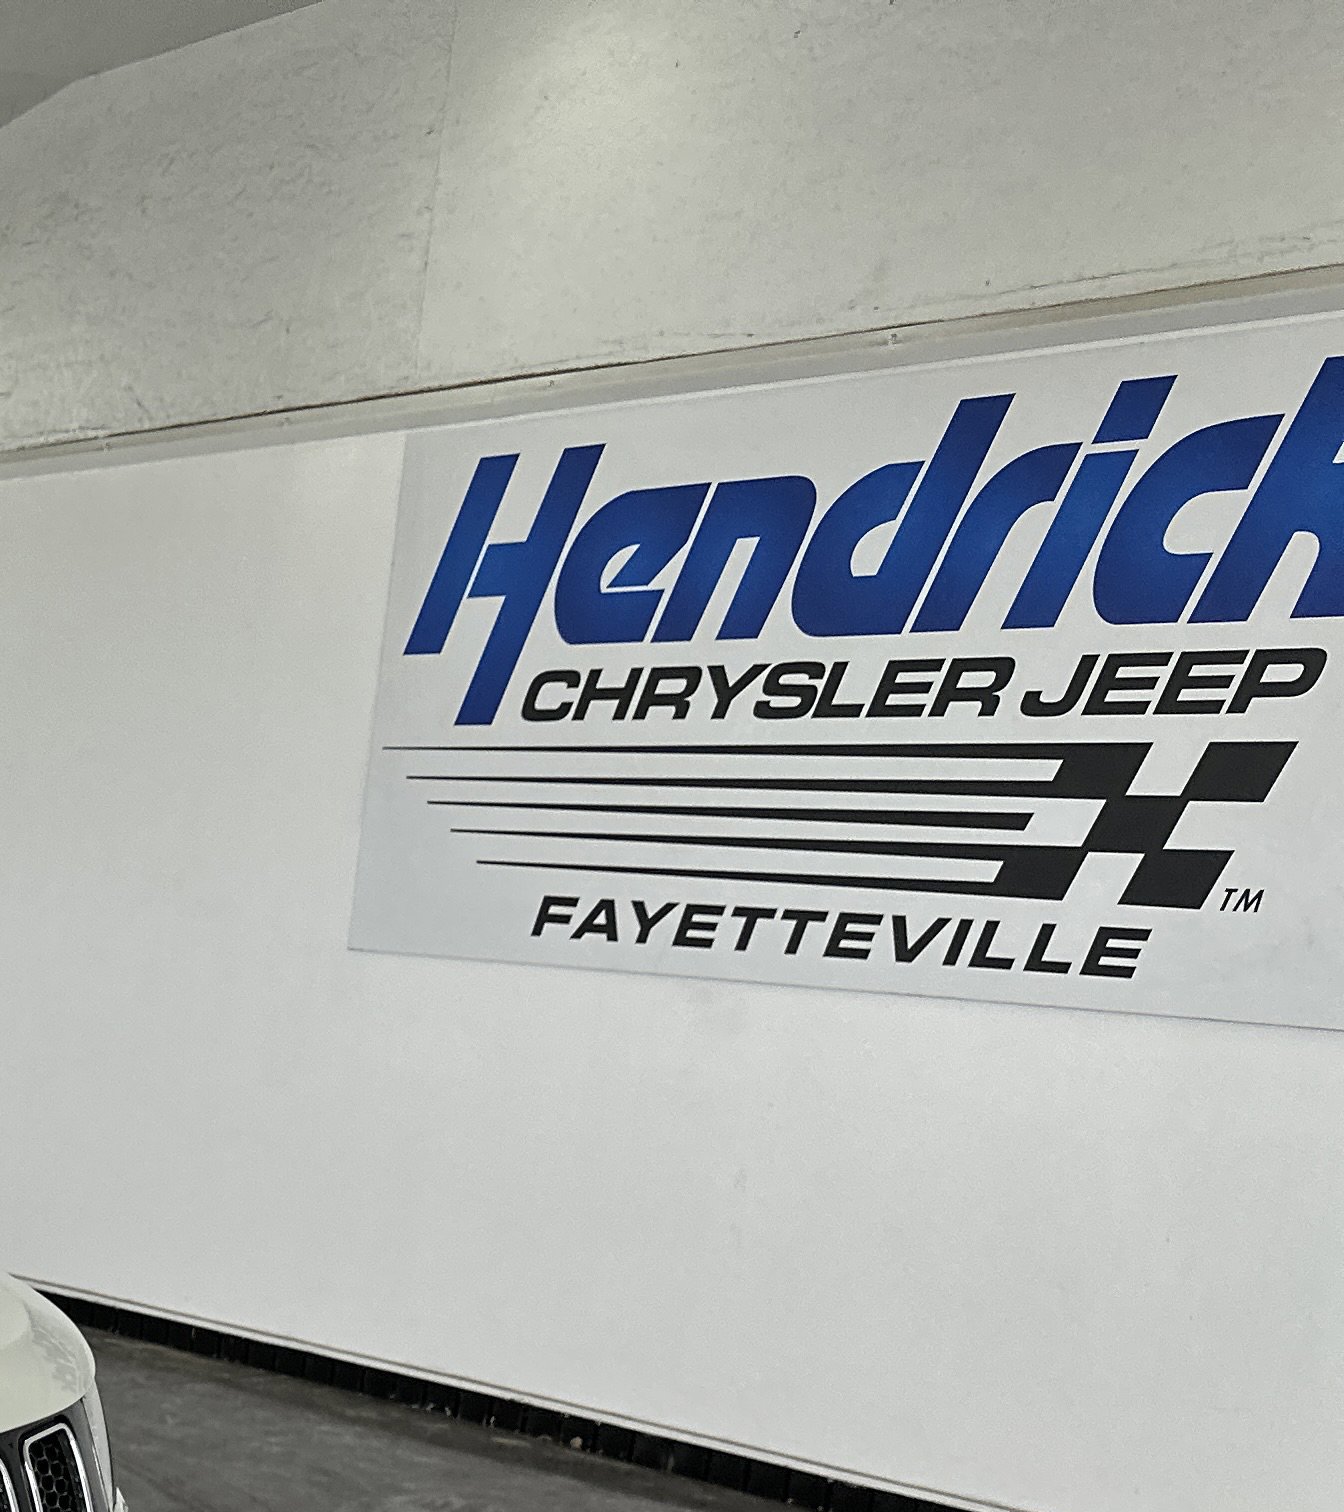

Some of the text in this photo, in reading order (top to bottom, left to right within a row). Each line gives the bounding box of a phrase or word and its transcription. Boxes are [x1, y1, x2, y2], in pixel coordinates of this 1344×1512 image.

[520, 647, 1328, 722] CHRYSLER JEEP
[530, 894, 1154, 980] FAYETTEVILLE
[1218, 887, 1265, 913] TM
